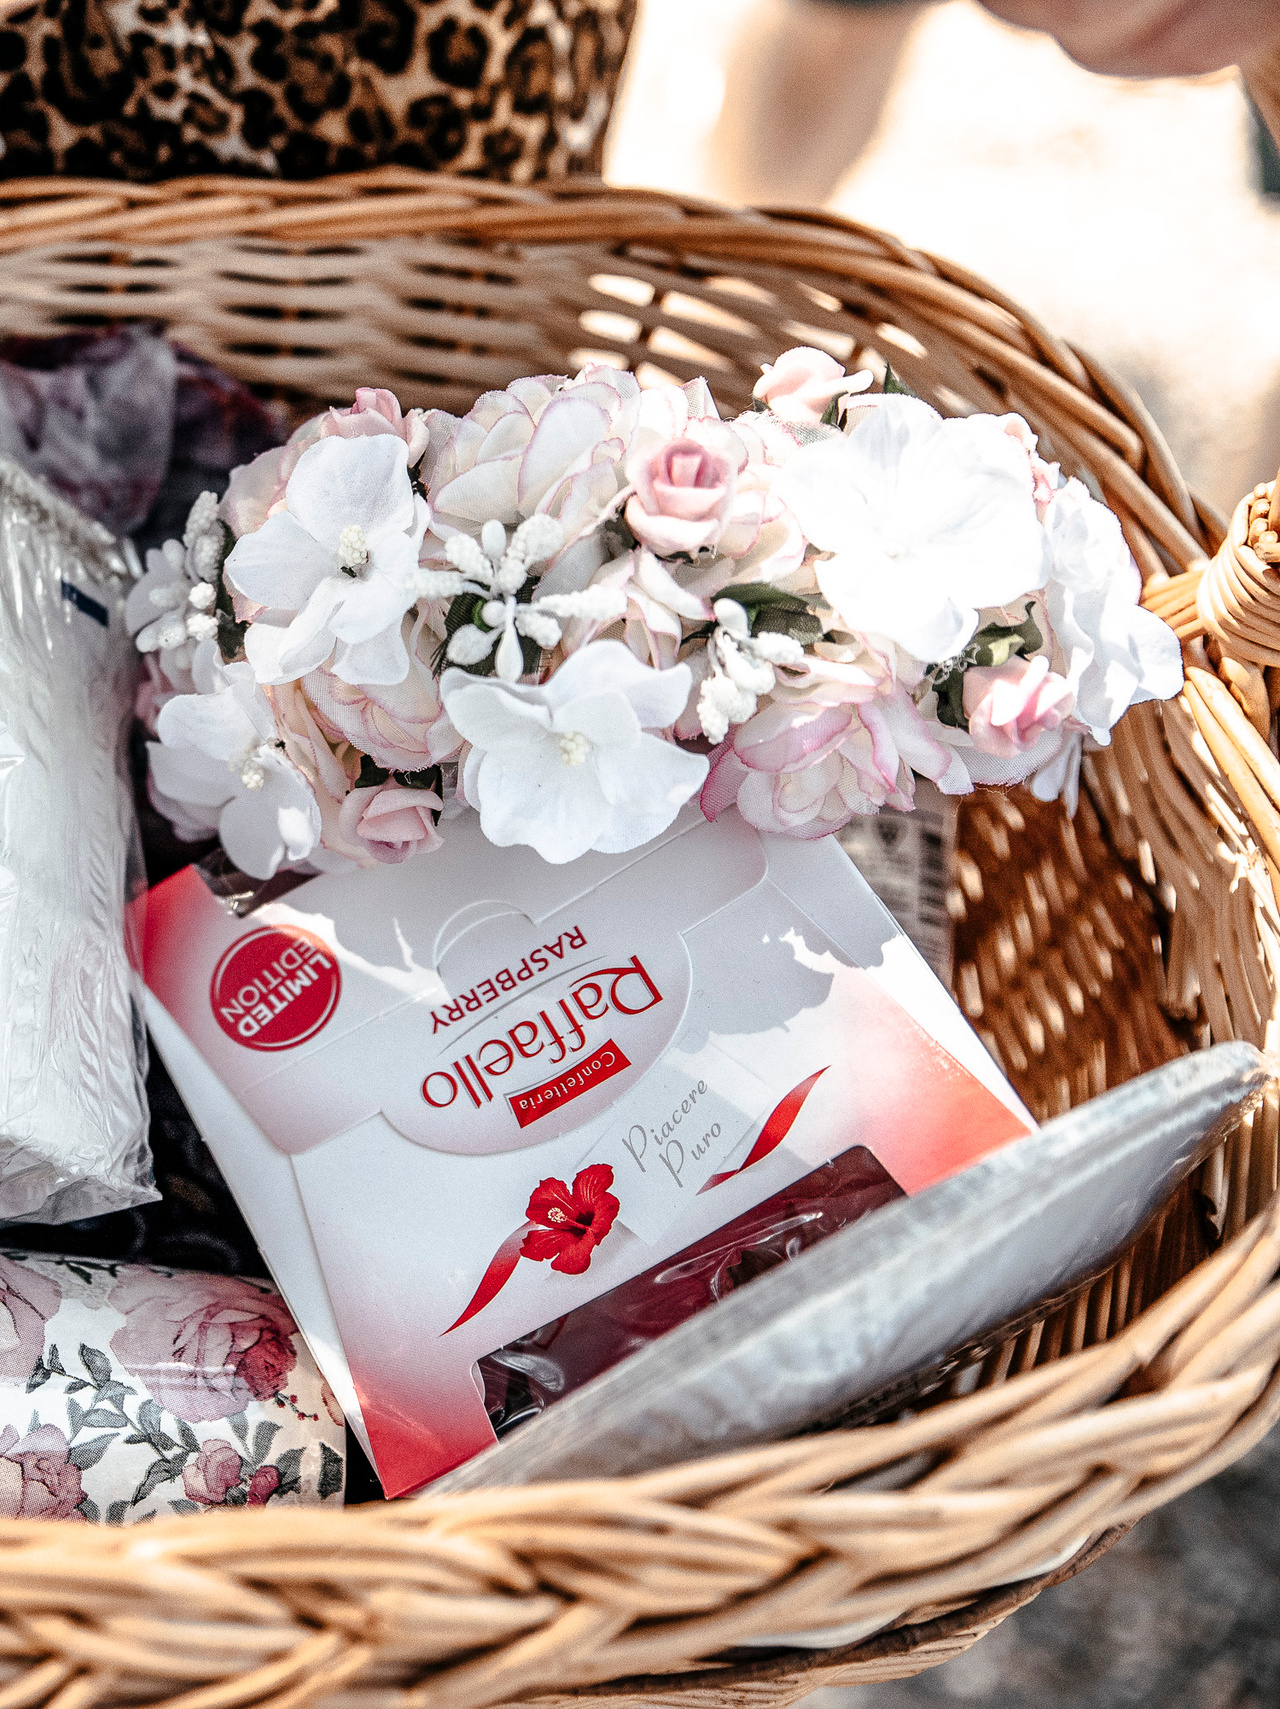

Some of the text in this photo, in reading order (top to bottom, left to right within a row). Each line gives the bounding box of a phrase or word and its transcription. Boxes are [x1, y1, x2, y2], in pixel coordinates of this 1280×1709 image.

[220, 937, 317, 1023] EDITION
[238, 953, 332, 1037] LIMITED
[429, 925, 588, 1035] RASPBERRY
[421, 954, 664, 1109] Raffaello
[519, 1051, 616, 1110] Confetteria
[621, 1079, 708, 1173] Piacere
[658, 1122, 722, 1188] Puro
